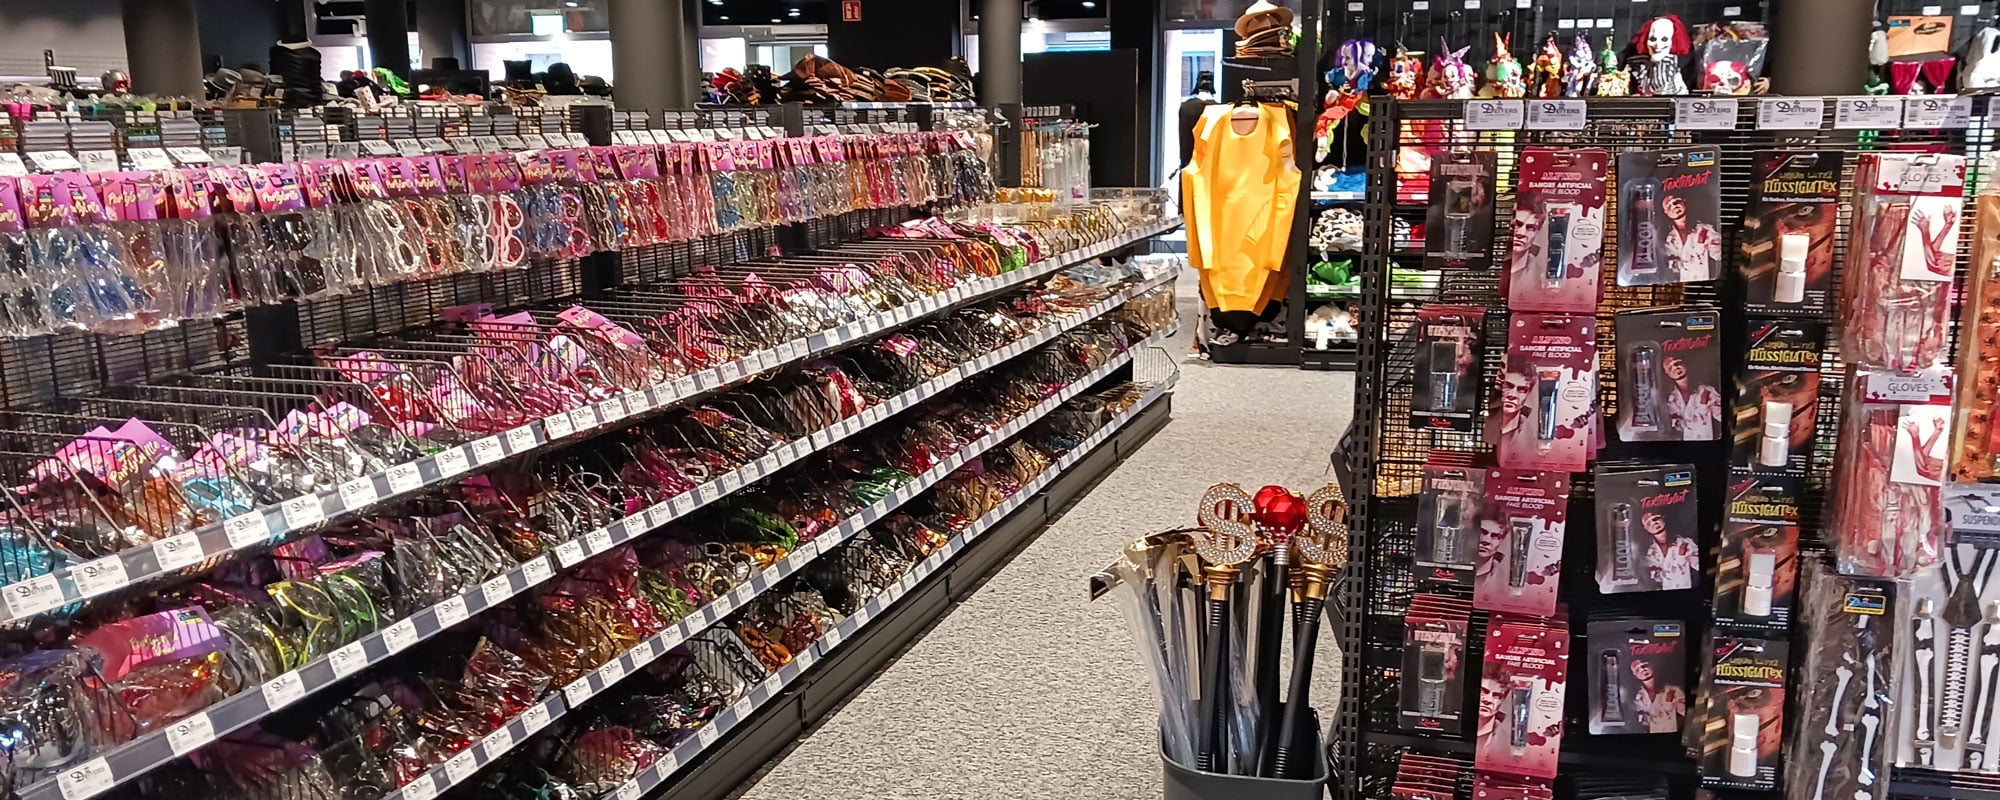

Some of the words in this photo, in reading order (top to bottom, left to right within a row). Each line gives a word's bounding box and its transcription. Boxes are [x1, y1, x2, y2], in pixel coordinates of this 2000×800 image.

[1547, 351, 1571, 359] BLOOD
[1888, 382, 1930, 393] GLOVES
[1521, 502, 1545, 510] BLOOD
